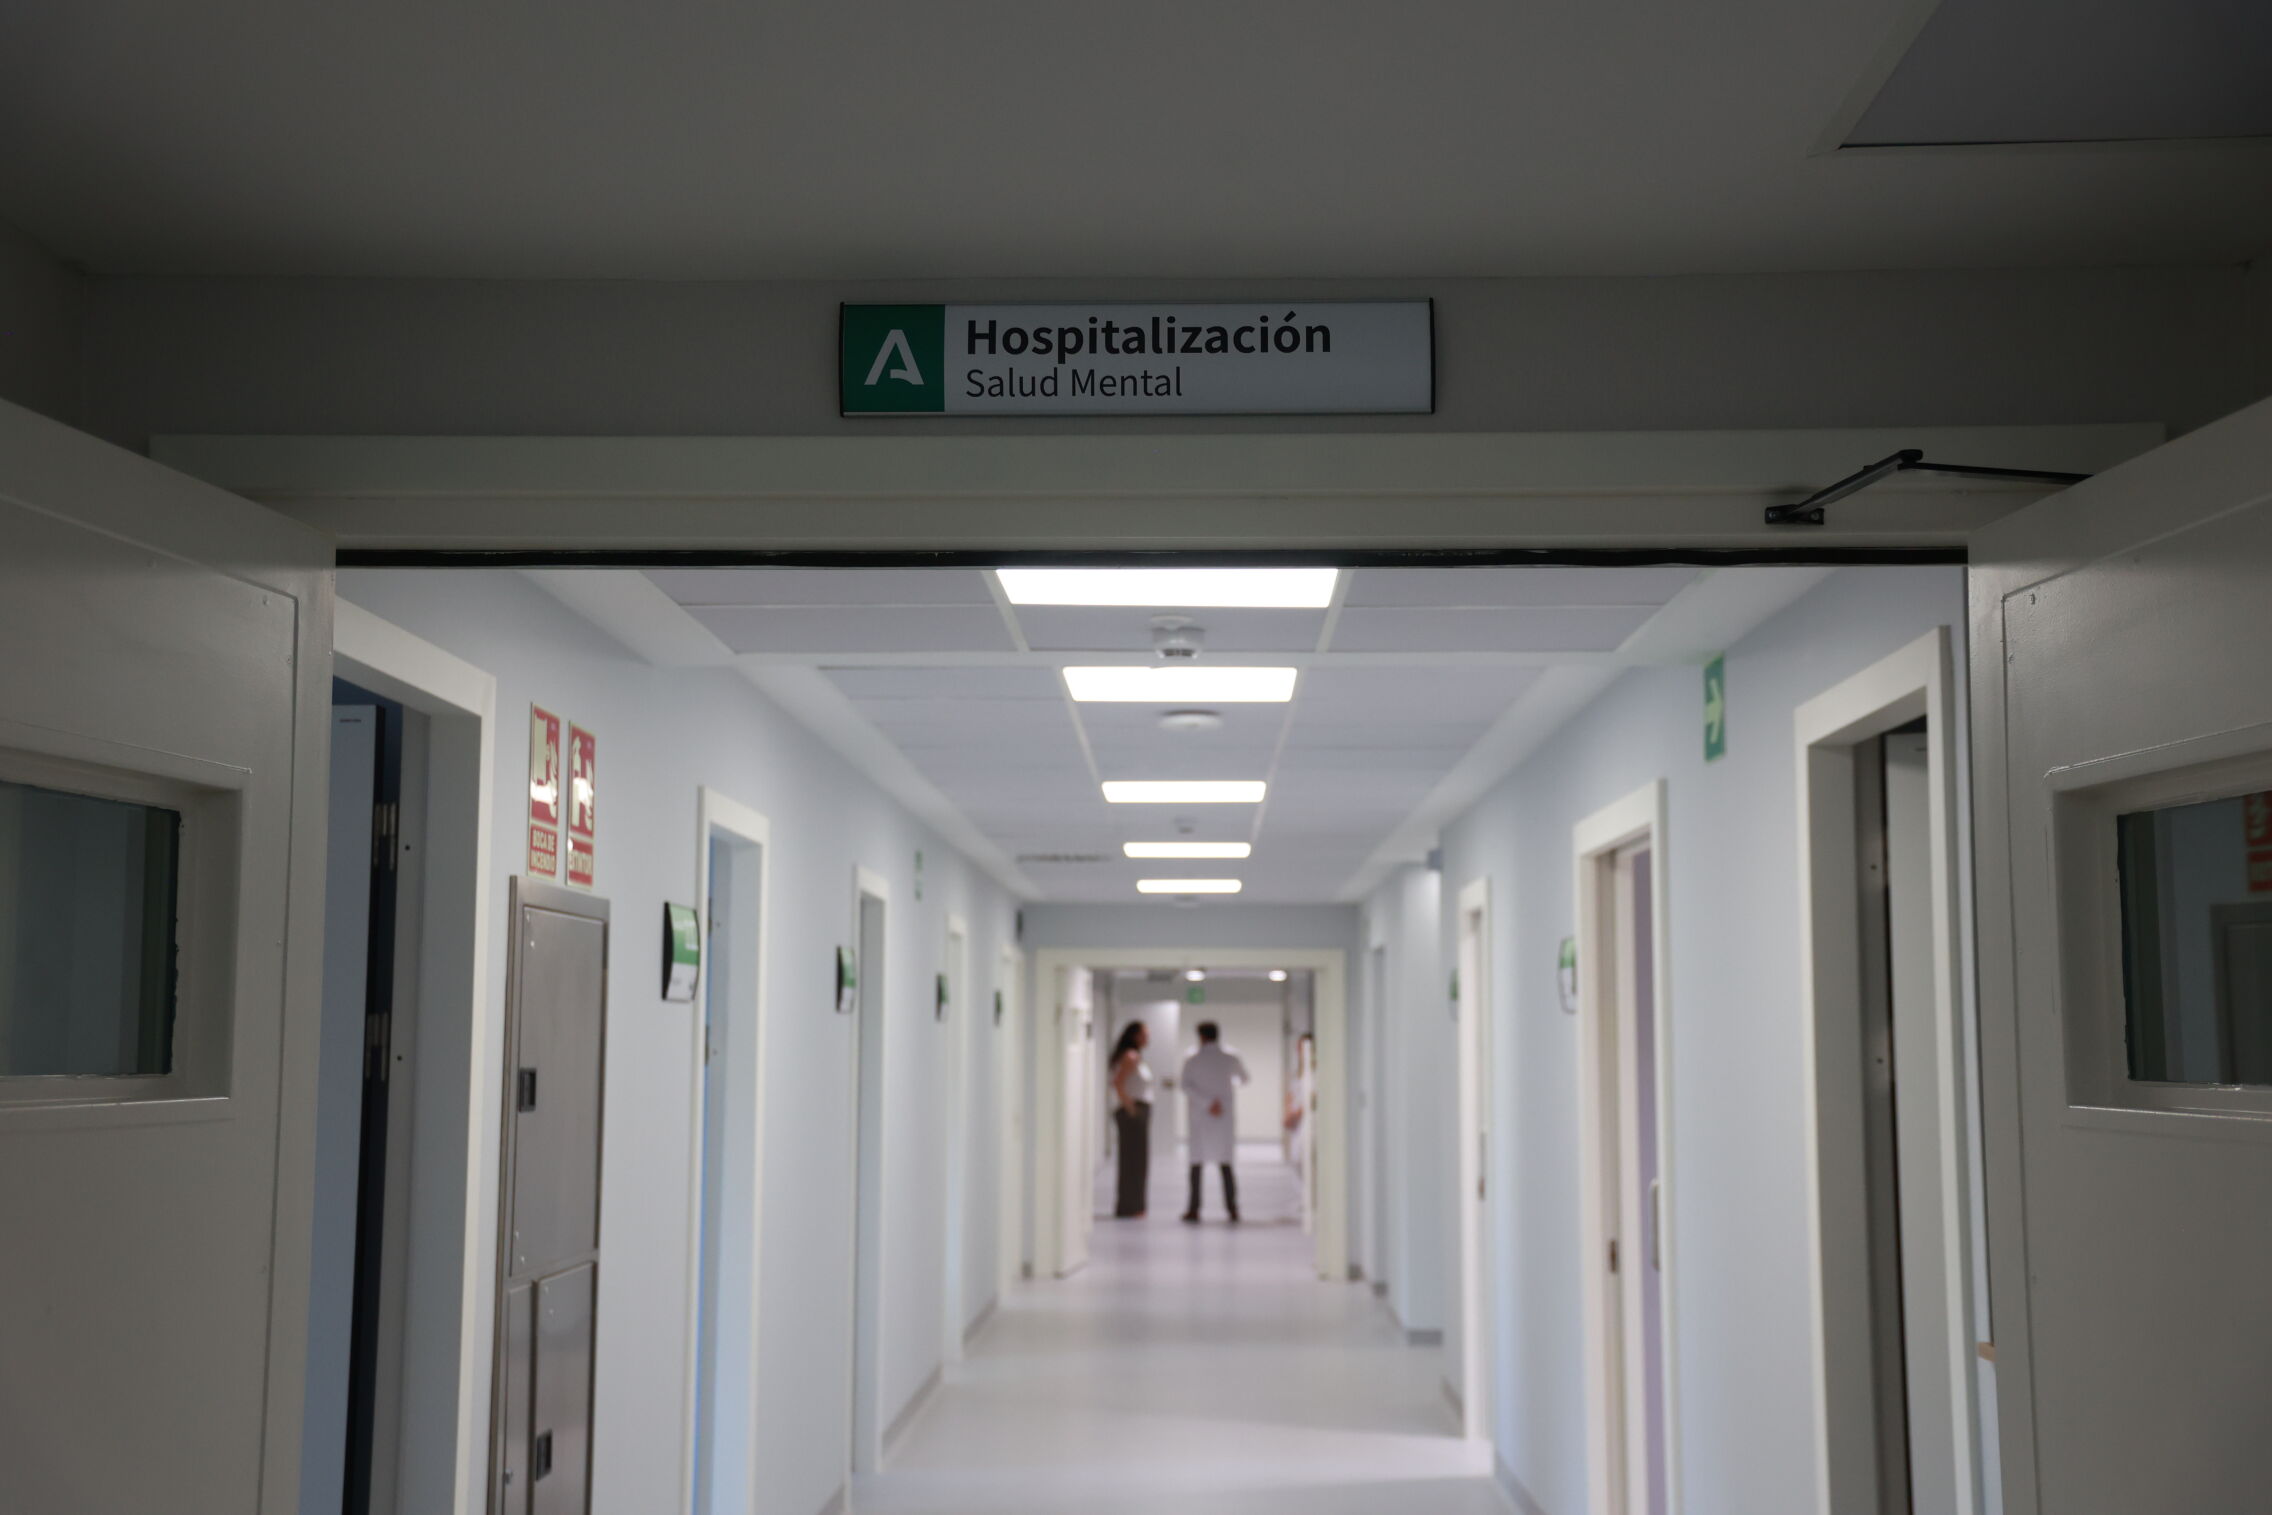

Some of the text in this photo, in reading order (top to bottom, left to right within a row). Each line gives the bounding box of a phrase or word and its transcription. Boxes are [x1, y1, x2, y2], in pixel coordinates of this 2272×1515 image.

[967, 311, 1331, 364] Hospitalización
[966, 366, 1182, 398] Salud Mental
